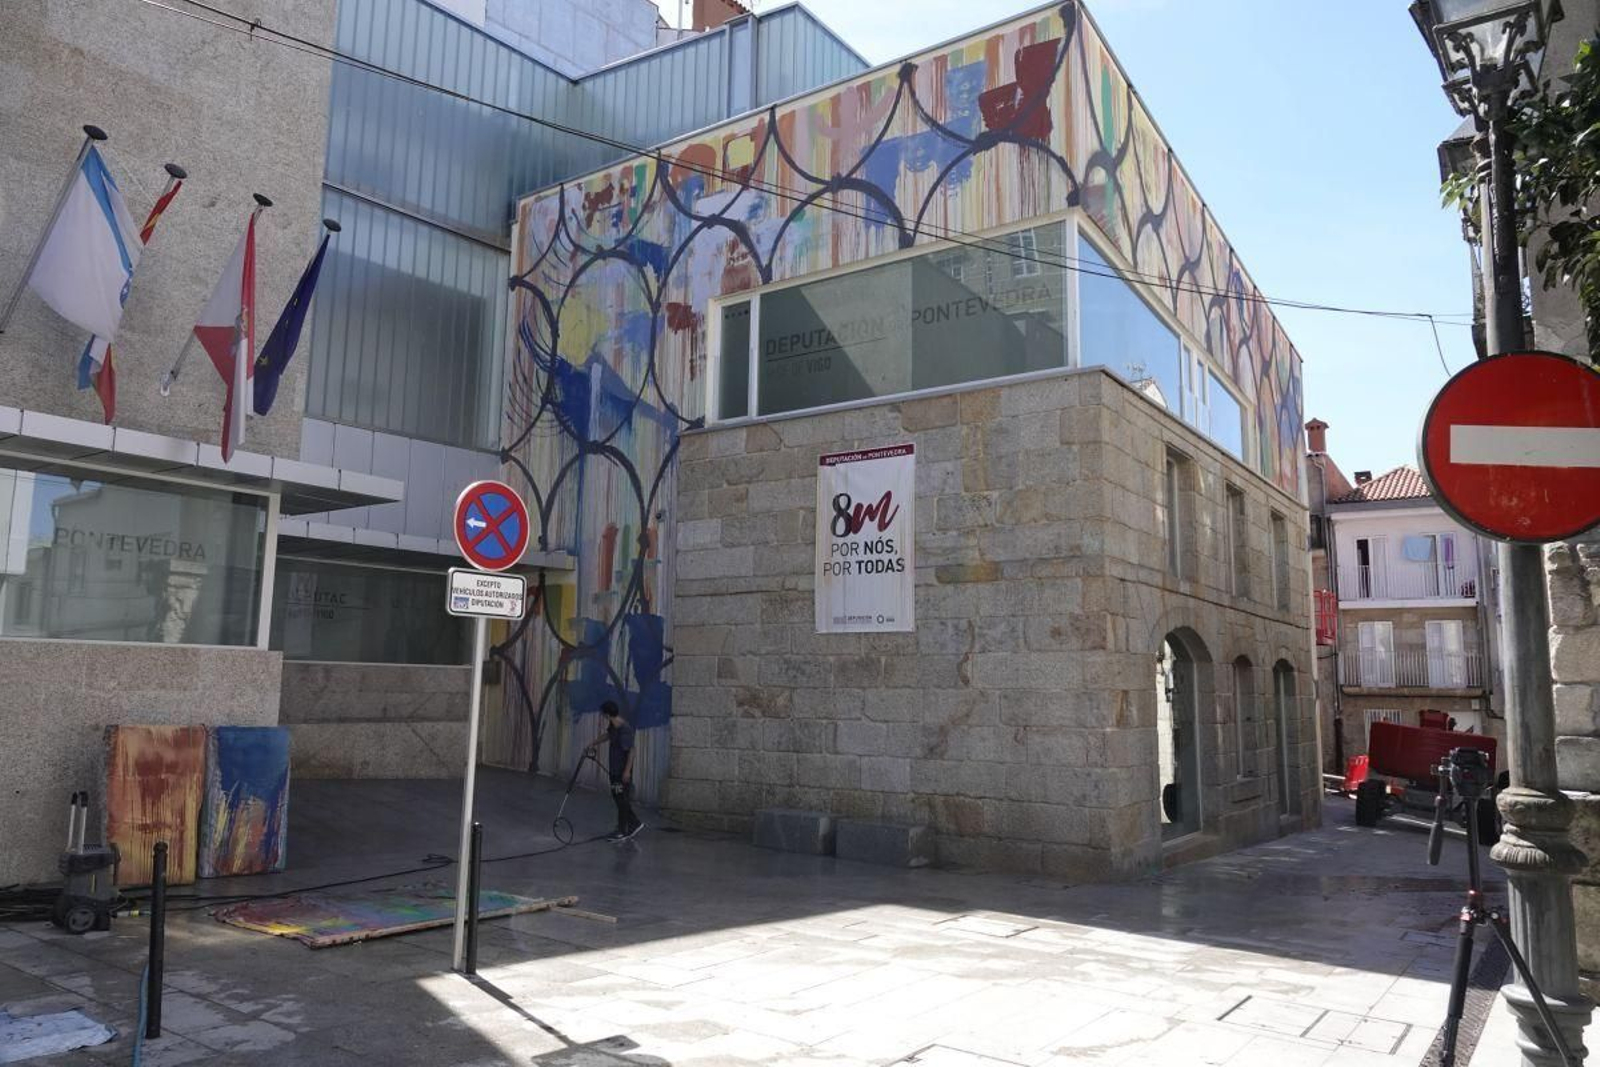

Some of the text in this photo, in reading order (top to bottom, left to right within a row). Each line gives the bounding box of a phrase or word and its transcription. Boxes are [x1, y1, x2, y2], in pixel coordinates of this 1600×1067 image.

[53, 527, 206, 560] PONTEVEDRA
[831, 536, 898, 558] POR NÓS,
[823, 557, 905, 577] POR TODAS
[476, 579, 502, 589] EXCEPTO
[484, 590, 523, 600] AUTORIZADOS
